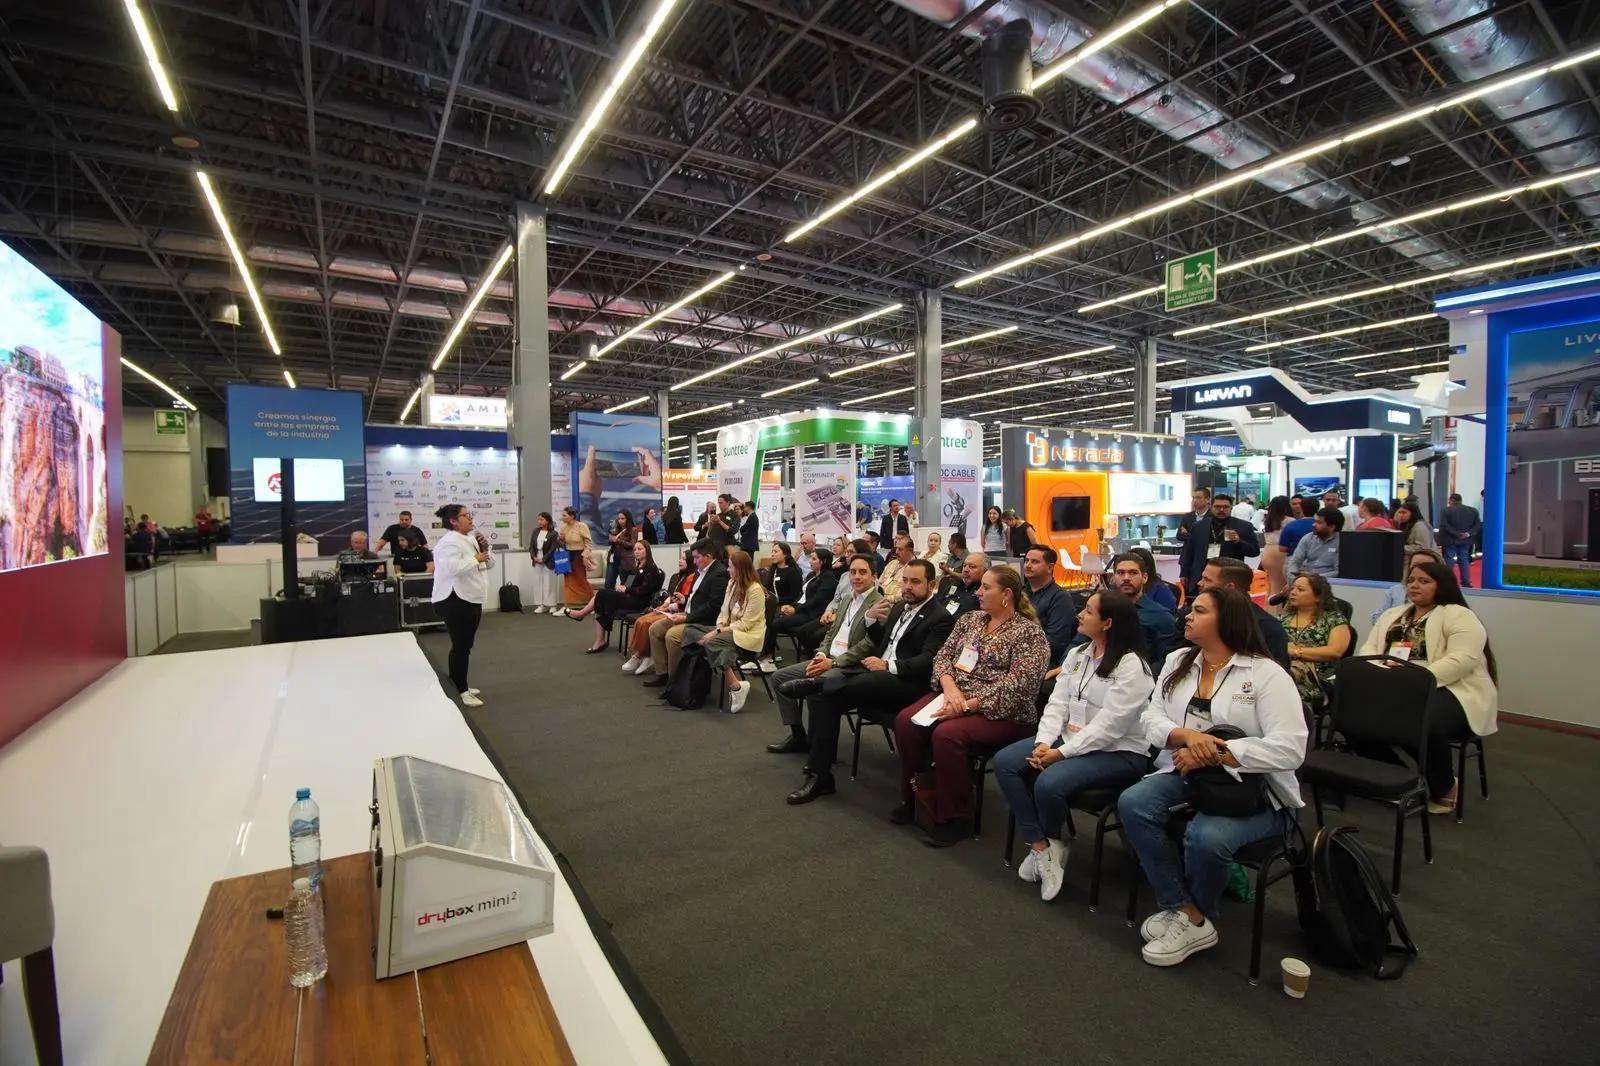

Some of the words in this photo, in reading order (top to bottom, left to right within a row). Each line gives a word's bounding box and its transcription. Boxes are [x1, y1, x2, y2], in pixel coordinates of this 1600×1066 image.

[257, 411, 300, 421] Creamos
[301, 413, 337, 424] sinergia
[254, 420, 279, 429] entre
[280, 421, 295, 429] las
[295, 423, 340, 432] empresas
[266, 430, 279, 438] de
[280, 430, 290, 438] la
[291, 431, 330, 440] industria
[723, 444, 749, 458] suntree
[950, 468, 976, 478] CABLE
[418, 905, 474, 926] drybox
